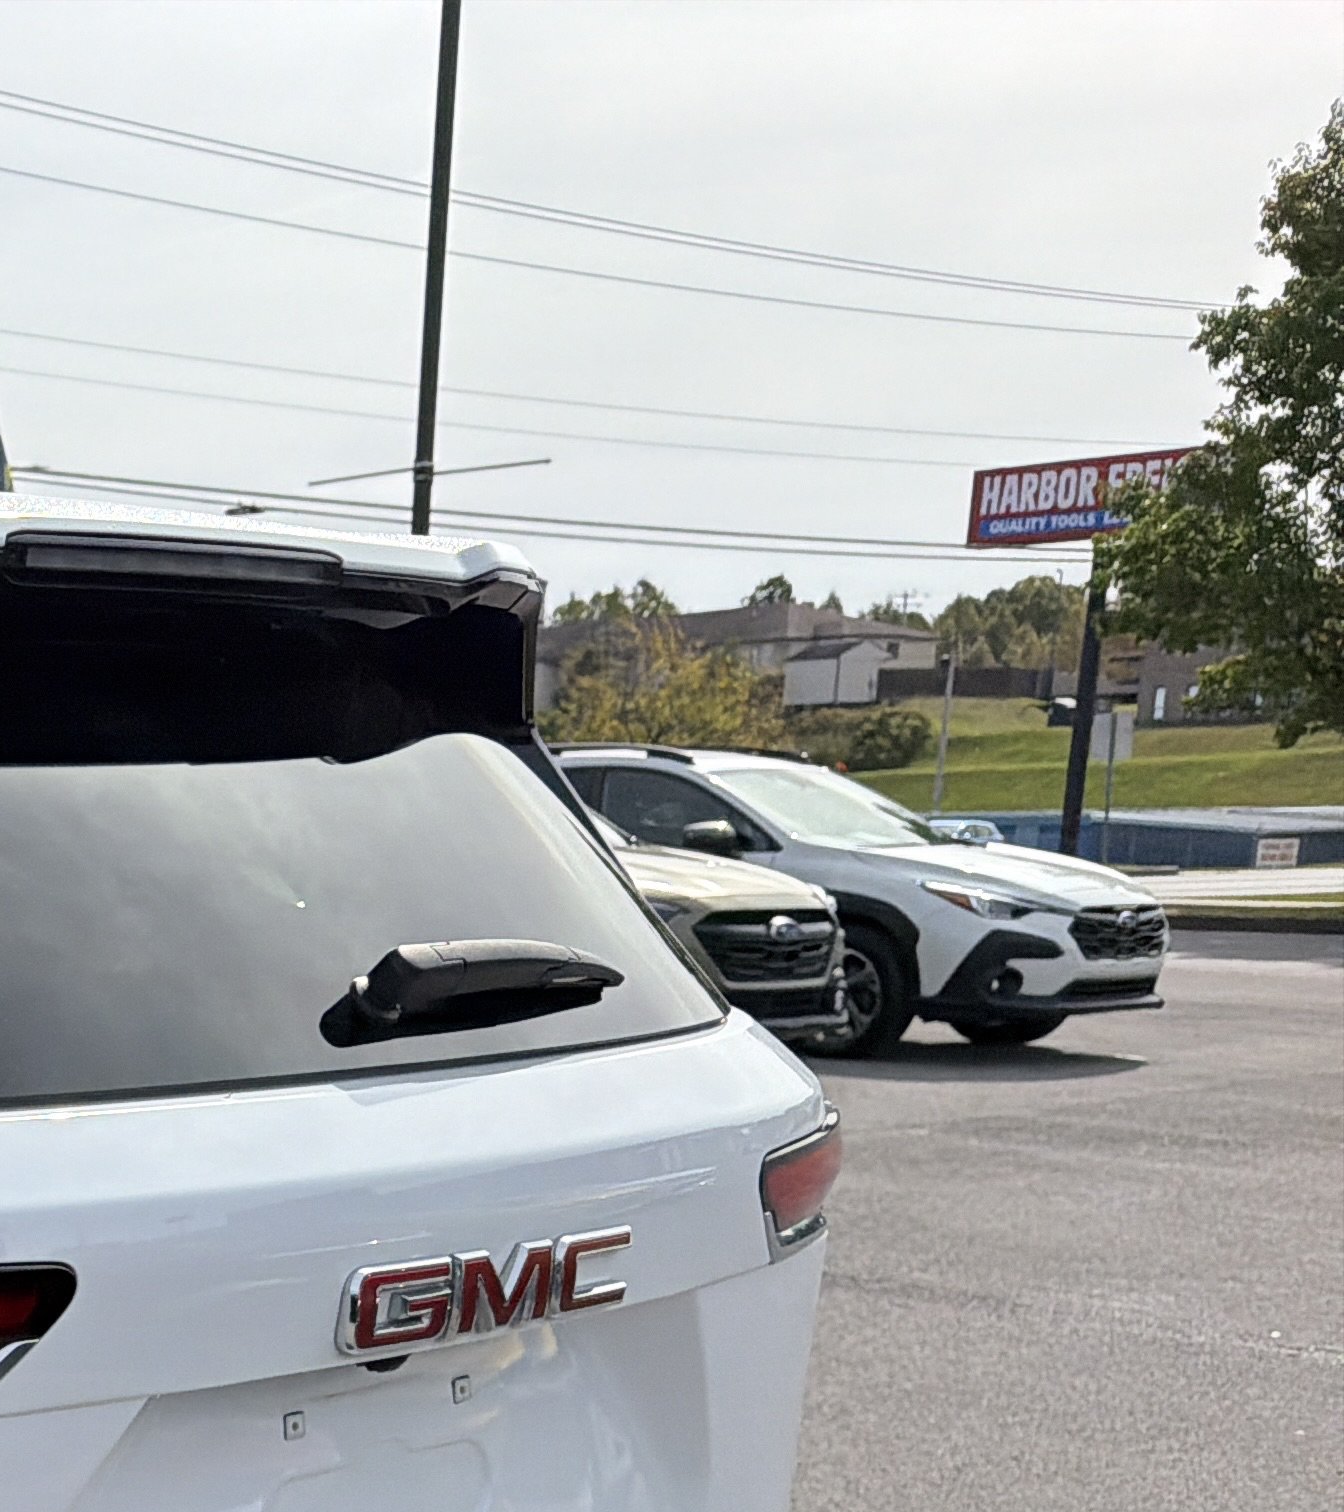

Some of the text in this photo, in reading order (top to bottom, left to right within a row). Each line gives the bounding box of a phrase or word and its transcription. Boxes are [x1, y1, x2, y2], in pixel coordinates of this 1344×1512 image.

[979, 466, 1099, 516] HARBOR
[988, 514, 1047, 534] QUALITY
[1050, 511, 1096, 530] TOOLS
[334, 1224, 632, 1355] GMC
